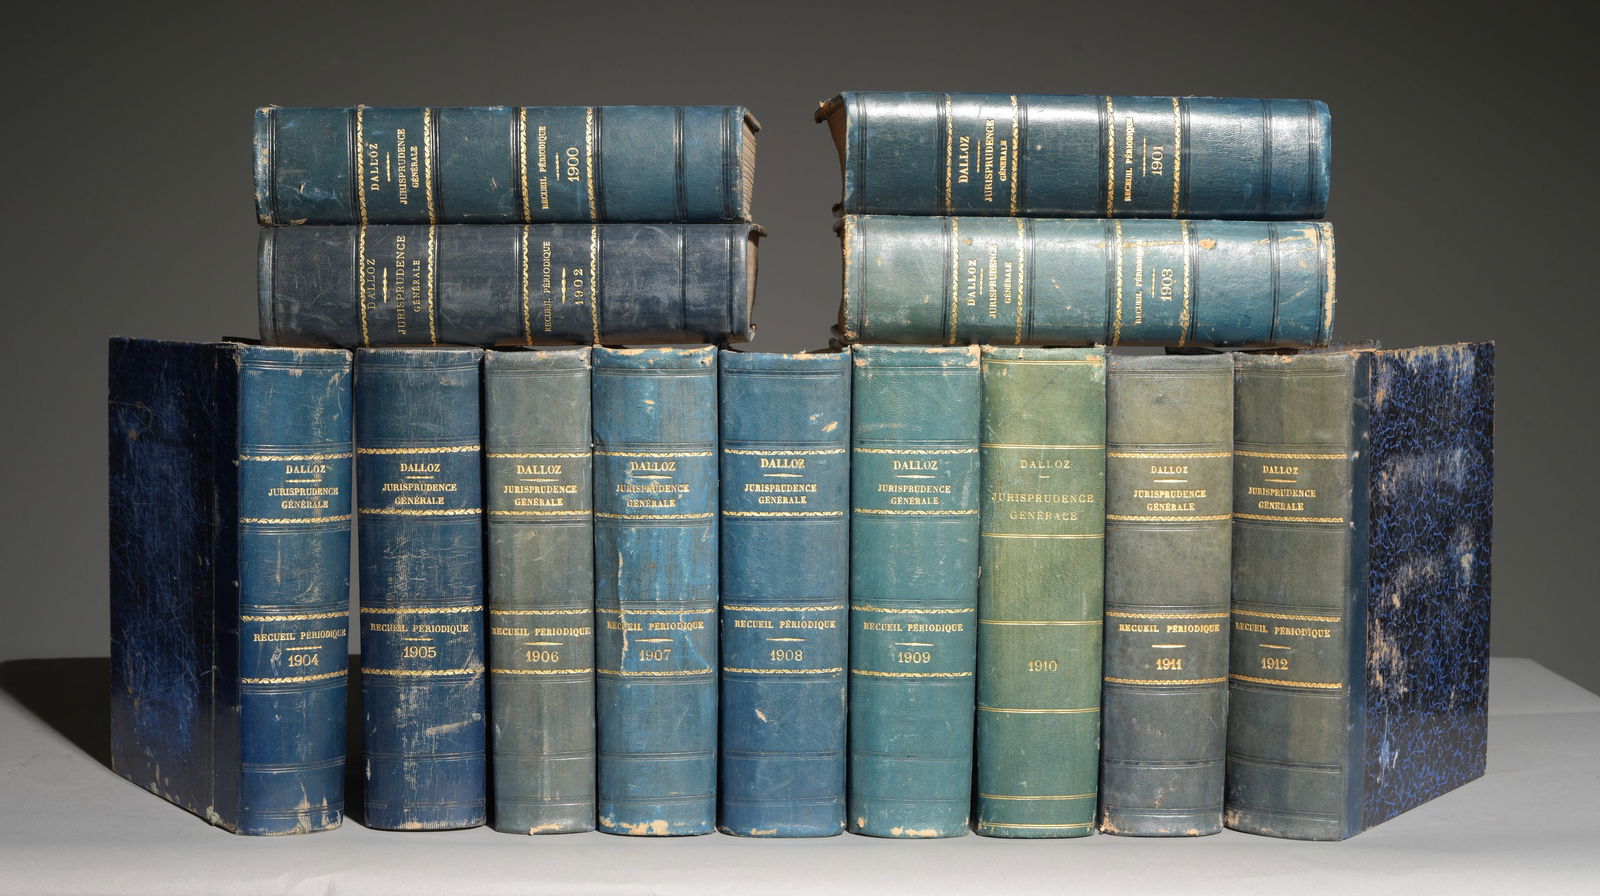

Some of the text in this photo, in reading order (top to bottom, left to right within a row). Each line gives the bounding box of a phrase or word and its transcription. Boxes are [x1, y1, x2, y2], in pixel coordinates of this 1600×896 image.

[1125, 117, 1135, 164] PÉRIODIQUE
[566, 147, 580, 182] 1900
[958, 136, 970, 183] DALLOZ
[984, 119, 995, 203] JURISPRUDENCE
[1151, 145, 1164, 176] 1901
[369, 143, 380, 191] DALLOZ
[397, 128, 408, 205] JURISPRUDENCE
[410, 145, 420, 189] GÉNÉRALE
[538, 126, 550, 210] RECUEIL PÉRIODIQUE
[366, 258, 377, 310] DALLOZ
[396, 235, 407, 335] JURISPRUDENCE
[412, 260, 421, 313] GÉNÉRALE
[542, 240, 552, 332] RECUEIL PÉRIODIQUE
[573, 268, 584, 305] 1902
[967, 259, 977, 306] DALLOZ
[988, 243, 998, 319] JURISPRUDENCE
[1160, 268, 1173, 302] 1903
[1135, 291, 1143, 324] RECUEIL
[400, 463, 441, 472] DALLOZ
[631, 461, 676, 471] DALLOZ
[760, 458, 805, 468] DALLOZ
[893, 460, 938, 470] DALLOZ
[1020, 459, 1070, 469] DALLOZ
[285, 464, 326, 474] DALLOZ
[516, 464, 562, 474] DALLOZ
[1151, 465, 1188, 474] DALLOZ
[1262, 465, 1299, 475] DALLOZ
[268, 487, 339, 496] JURISPRUDENCE
[382, 483, 457, 492] JURISPRUDENCE
[503, 485, 578, 494] JURISPRUDENCE
[616, 484, 690, 493] JURISPRUDENCE
[744, 483, 817, 492] JURISPRUDENCE
[878, 484, 951, 493] JURISPRUDENCE
[1248, 486, 1317, 497] JURISPRUDENCE
[991, 492, 1094, 503] JURISPRUDENCE
[1133, 489, 1207, 498] JURISPRUDENCE
[281, 499, 329, 509] GÉNÉRALE
[514, 497, 564, 506] GÉNÉRALE
[1146, 502, 1195, 511] GÉNÉRALE
[1258, 501, 1304, 511] GÉNÉRALE
[370, 623, 408, 632] RECUEIL
[735, 619, 836, 630] RECUEIL PÉRIODIQUE
[863, 622, 902, 632] RECUEIL
[1119, 623, 1220, 633] RECUEIL PÉRIODIQUE
[1235, 622, 1331, 638] RECUEIL PÉRIODIQUE
[253, 632, 296, 642] RECUEIL
[491, 627, 530, 636] RECUEIL
[403, 646, 437, 658] 1905
[525, 650, 559, 662] 1906
[640, 649, 671, 661] 1907
[770, 649, 803, 661] 1908
[897, 651, 931, 663] 1909
[288, 653, 319, 667] 1904
[1156, 658, 1182, 670] 1911
[1261, 657, 1289, 670] 1912
[1028, 660, 1057, 672] 1910
